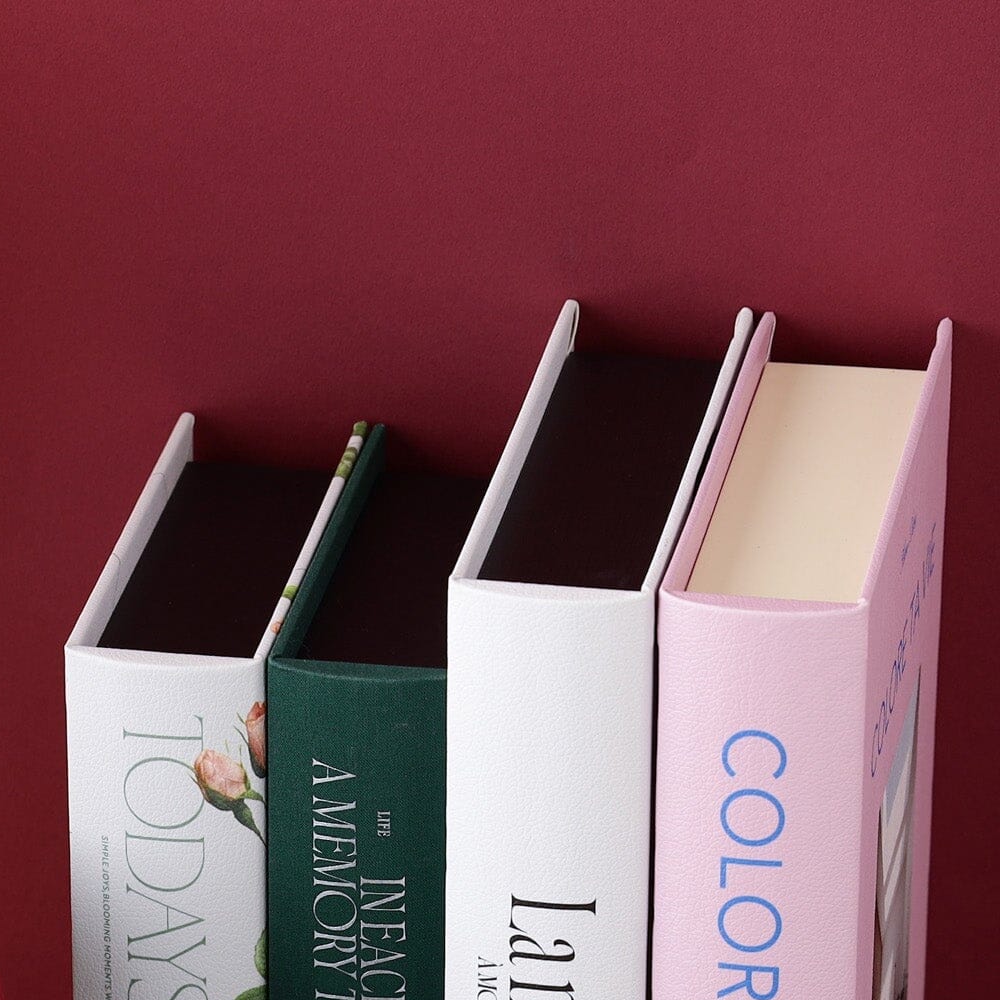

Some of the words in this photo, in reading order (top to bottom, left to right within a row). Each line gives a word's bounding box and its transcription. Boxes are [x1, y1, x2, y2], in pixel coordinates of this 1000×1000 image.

[312, 757, 357, 786] A
[377, 810, 391, 838] LIFE
[101, 834, 110, 869] SIMPLE
[312, 795, 358, 981] MEMORY
[360, 876, 406, 914] IN
